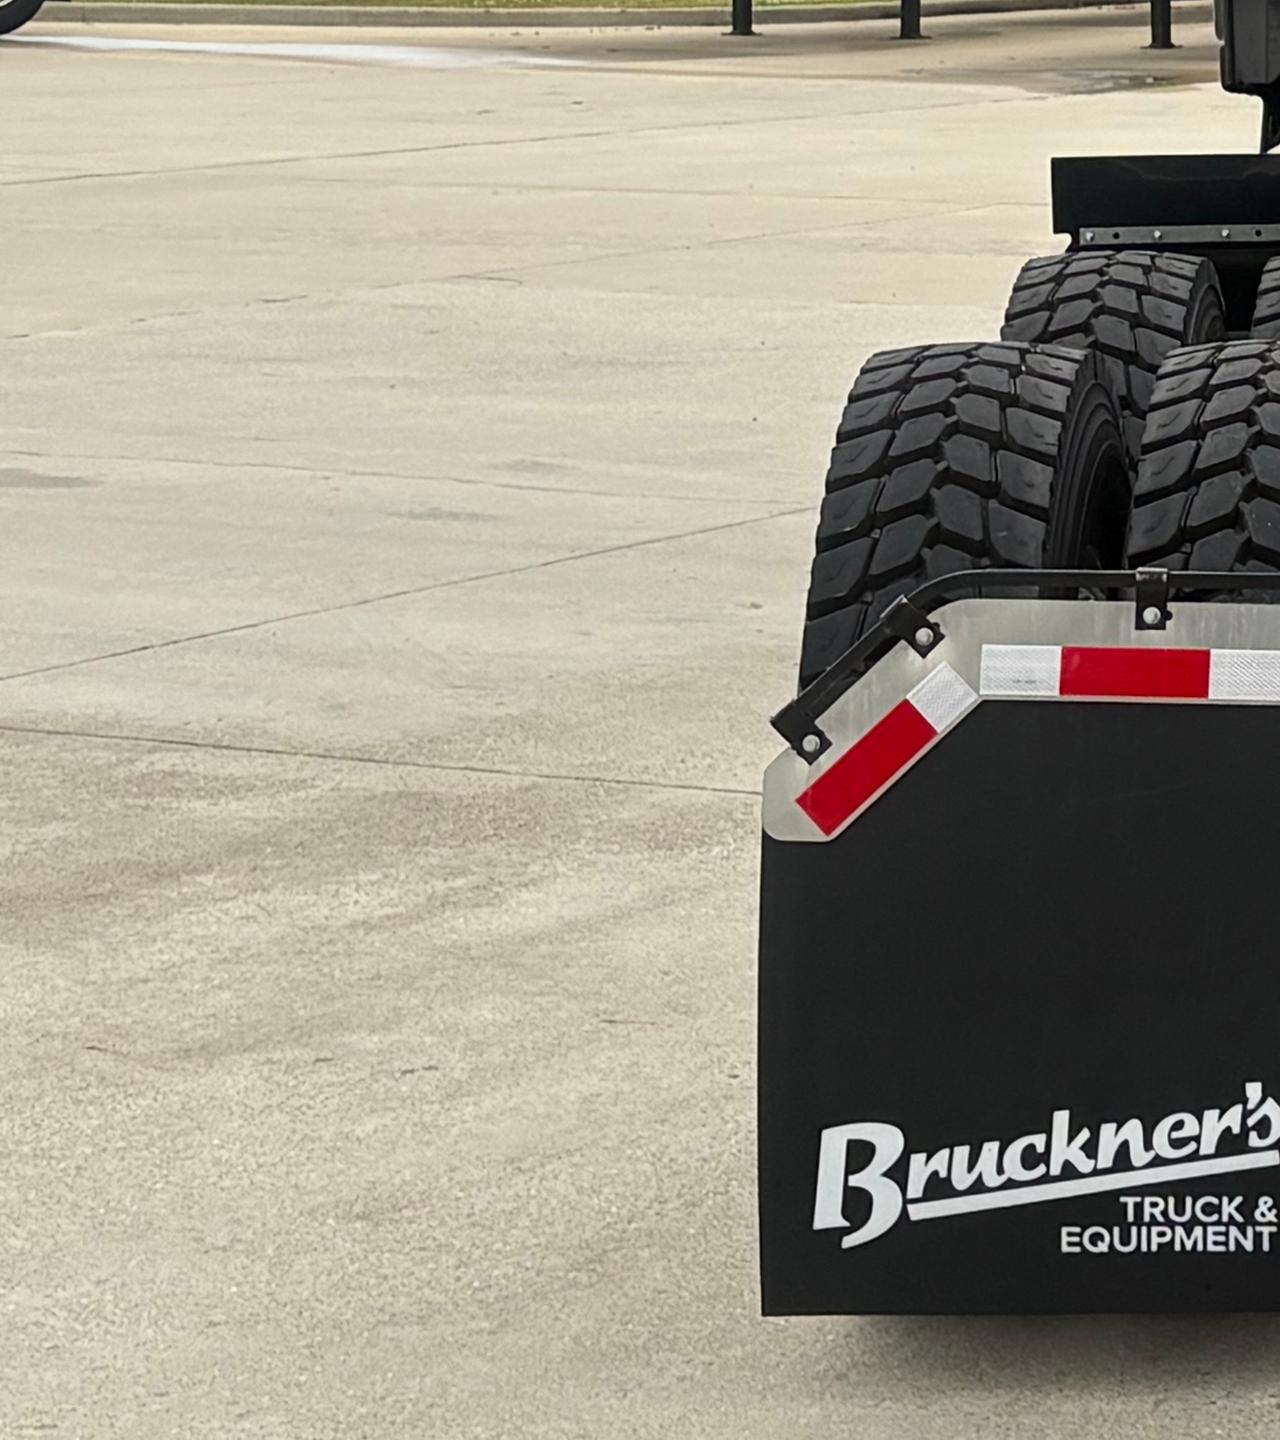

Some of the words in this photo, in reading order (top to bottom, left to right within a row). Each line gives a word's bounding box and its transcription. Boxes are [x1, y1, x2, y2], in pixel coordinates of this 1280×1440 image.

[1119, 1195, 1245, 1223] TRUCK
[1254, 1195, 1279, 1223] &
[1060, 1225, 1278, 1254] EQUIPMENT
